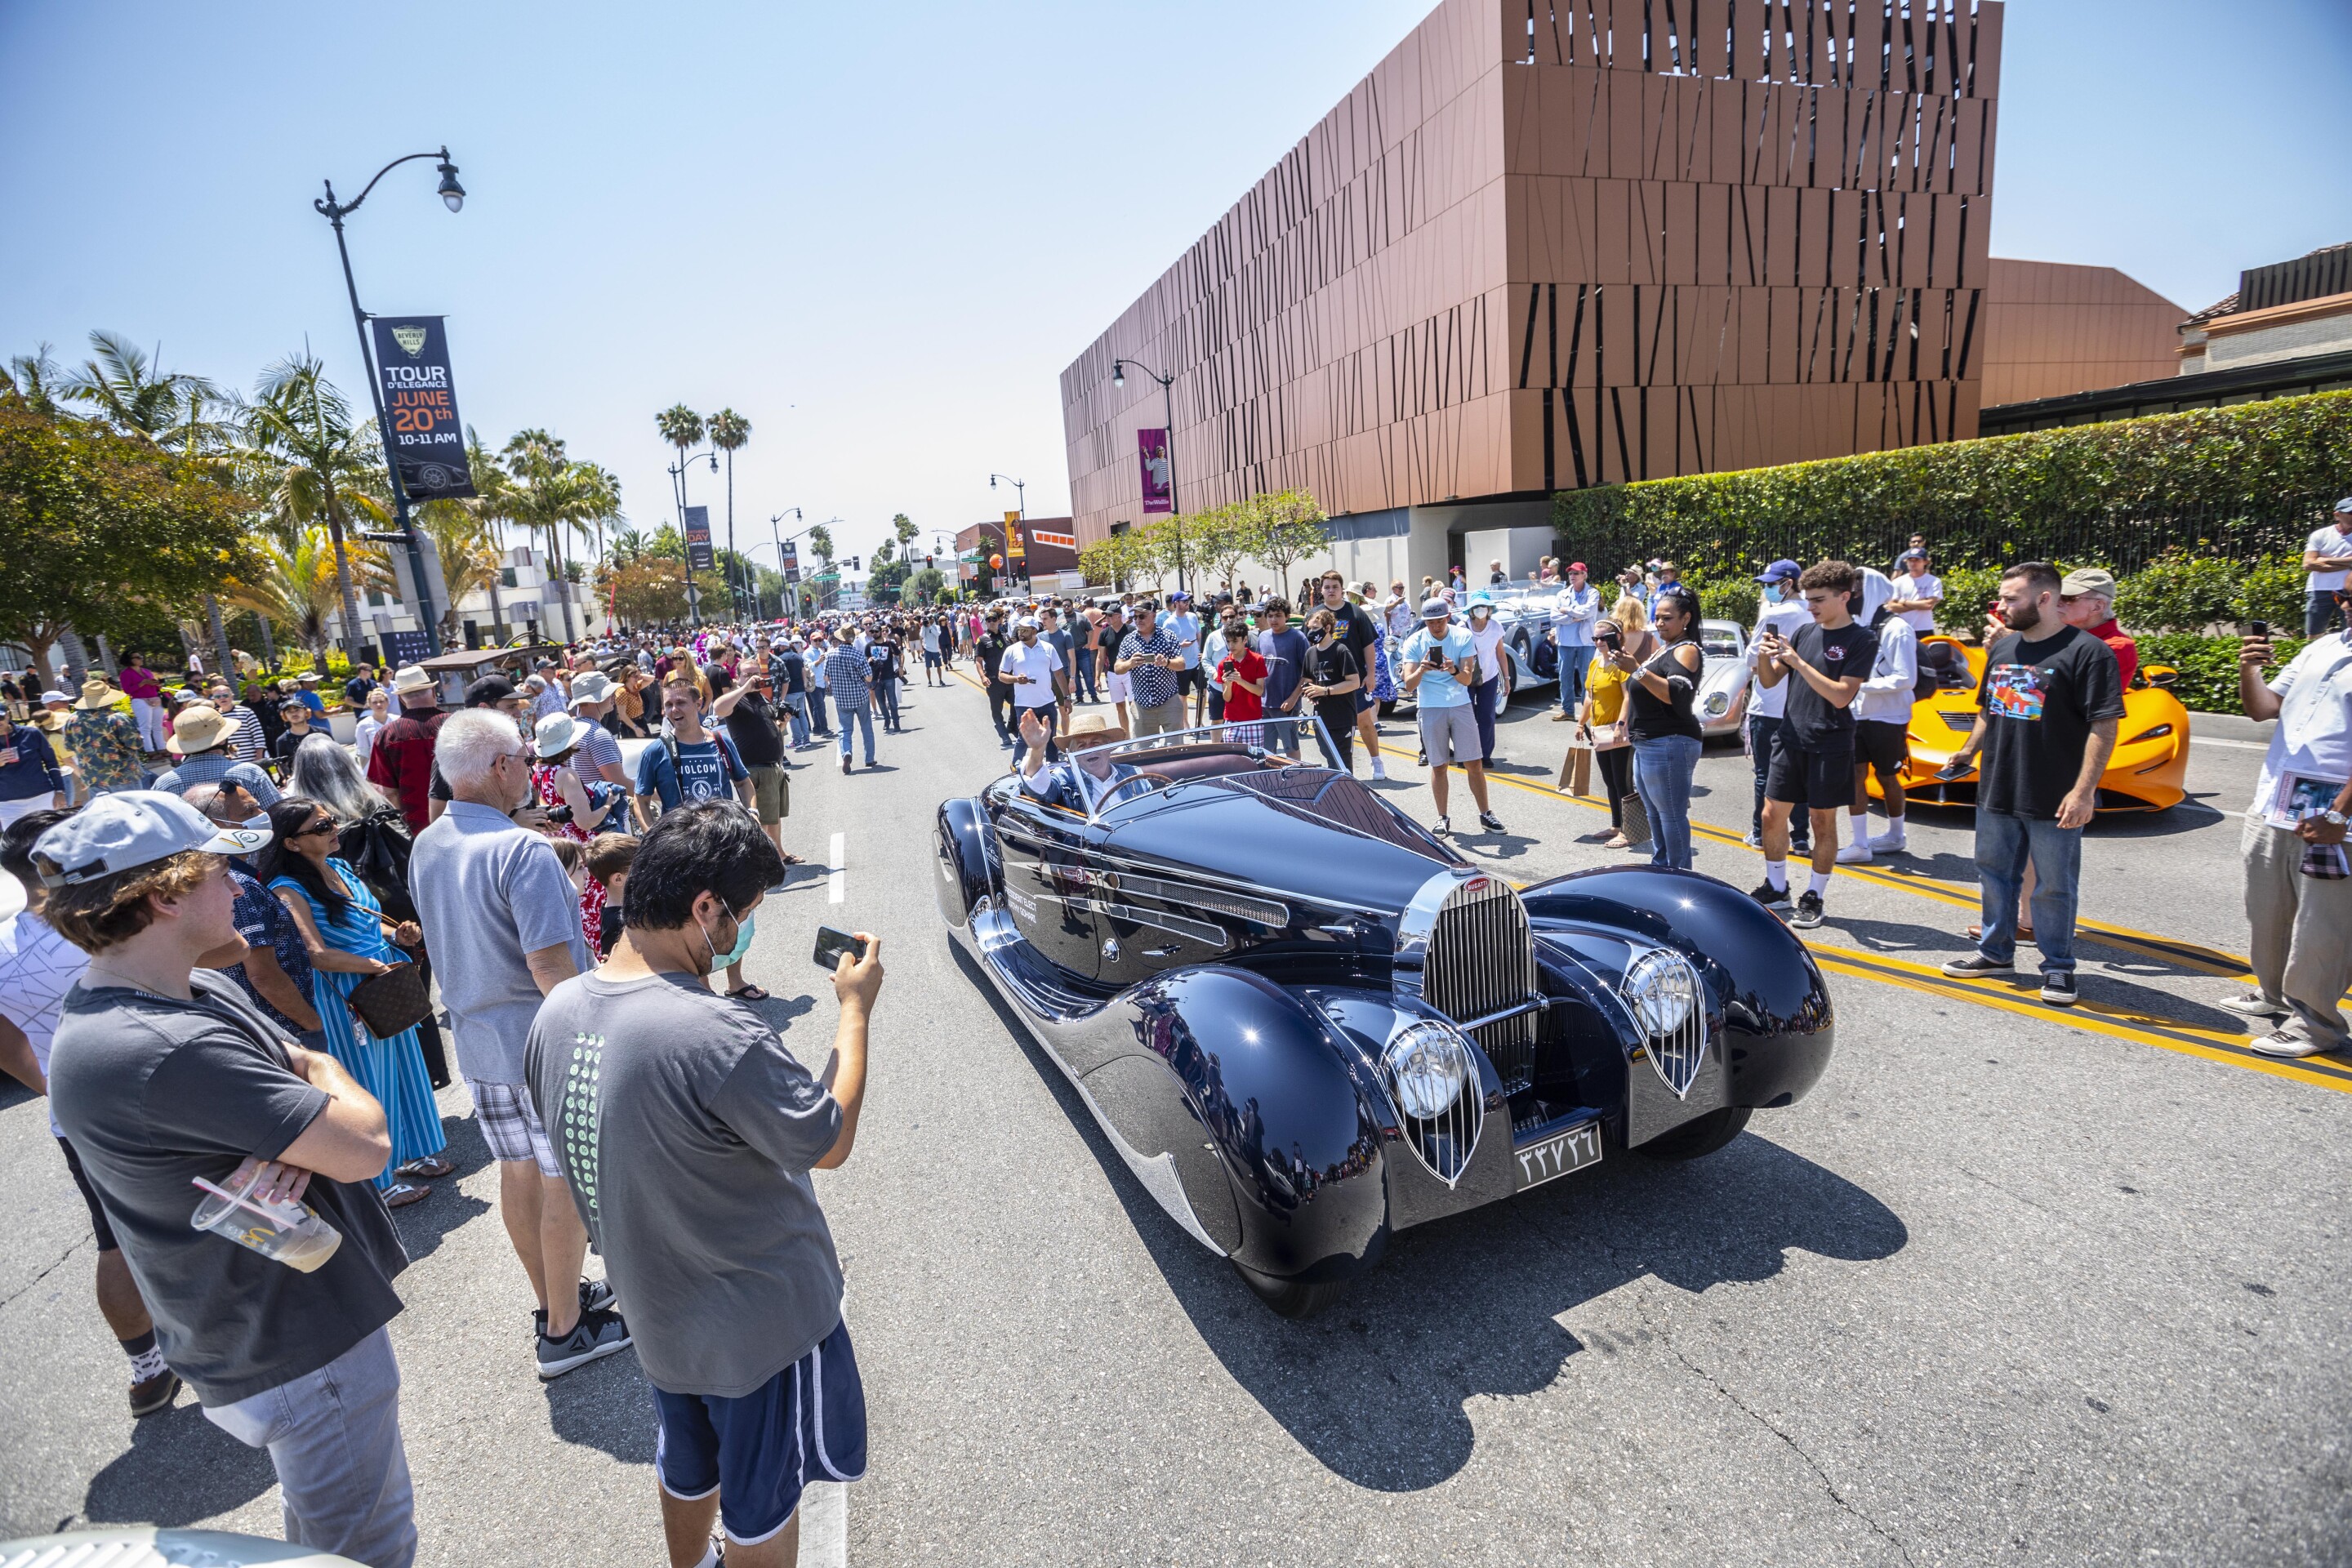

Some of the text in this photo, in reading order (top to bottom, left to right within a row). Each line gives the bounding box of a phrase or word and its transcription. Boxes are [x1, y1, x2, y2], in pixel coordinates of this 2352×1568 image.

[398, 332, 423, 340] BEVERLY
[385, 366, 447, 381] TOUR
[387, 381, 448, 390] D'ELEGANCE
[392, 390, 450, 407] JUNE
[394, 408, 452, 432] 20th
[399, 432, 457, 445] 10-11 AM
[688, 533, 710, 542] DAY
[1468, 881, 1488, 890] BUGATTI
[1022, 898, 1037, 912] ELECT
